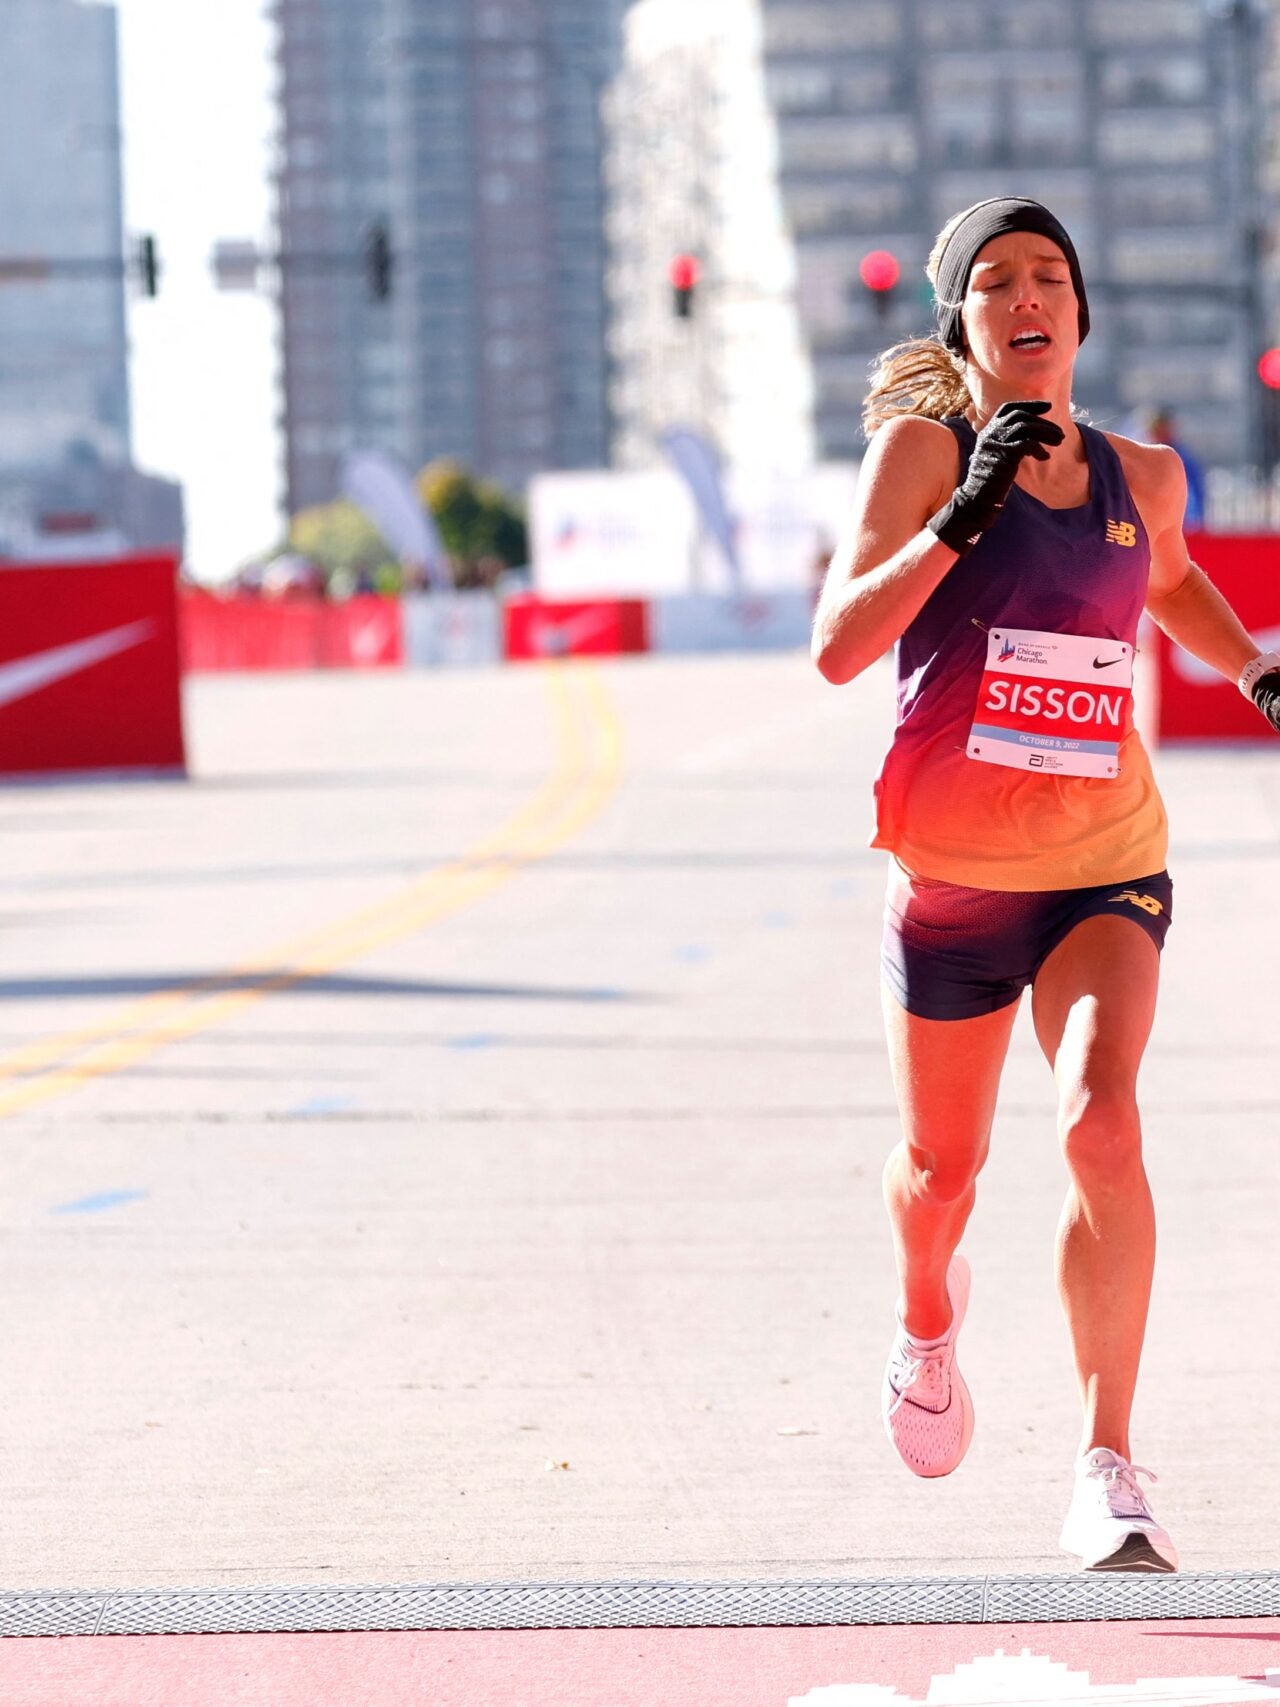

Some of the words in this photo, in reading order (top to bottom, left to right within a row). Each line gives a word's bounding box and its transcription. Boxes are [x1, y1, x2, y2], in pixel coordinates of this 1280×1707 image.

[1017, 647, 1043, 657] Chicago
[1016, 655, 1048, 664] Marathon
[985, 680, 1123, 726] SISSON
[1019, 735, 1054, 746] OCTOBER
[1063, 741, 1080, 750] 2022
